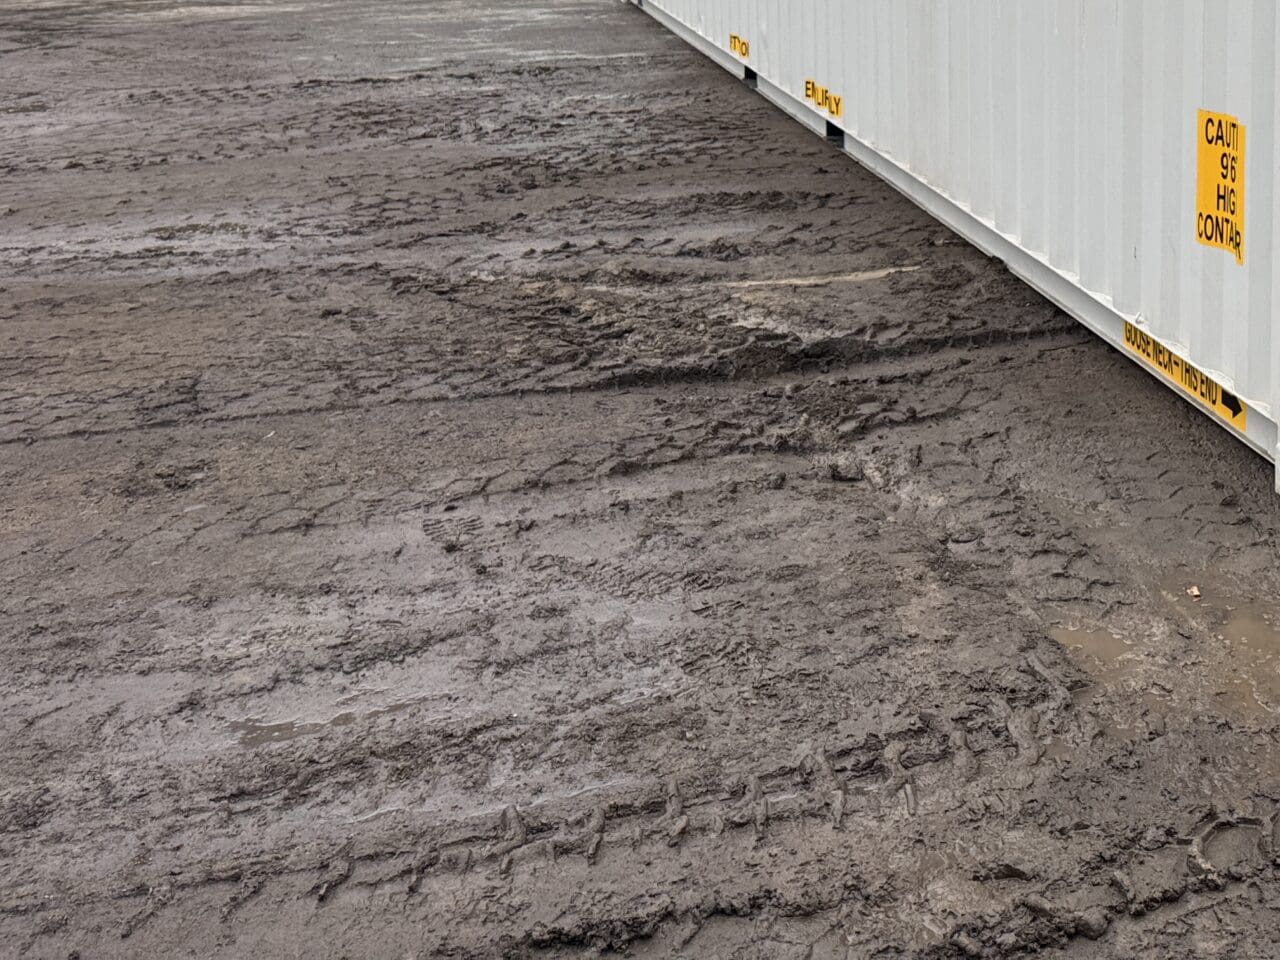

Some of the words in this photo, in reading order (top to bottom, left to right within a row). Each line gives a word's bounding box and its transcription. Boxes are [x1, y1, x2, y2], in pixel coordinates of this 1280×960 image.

[1216, 183, 1237, 216] HIG
[1124, 320, 1151, 359] GOOSE
[1200, 368, 1218, 406] END
